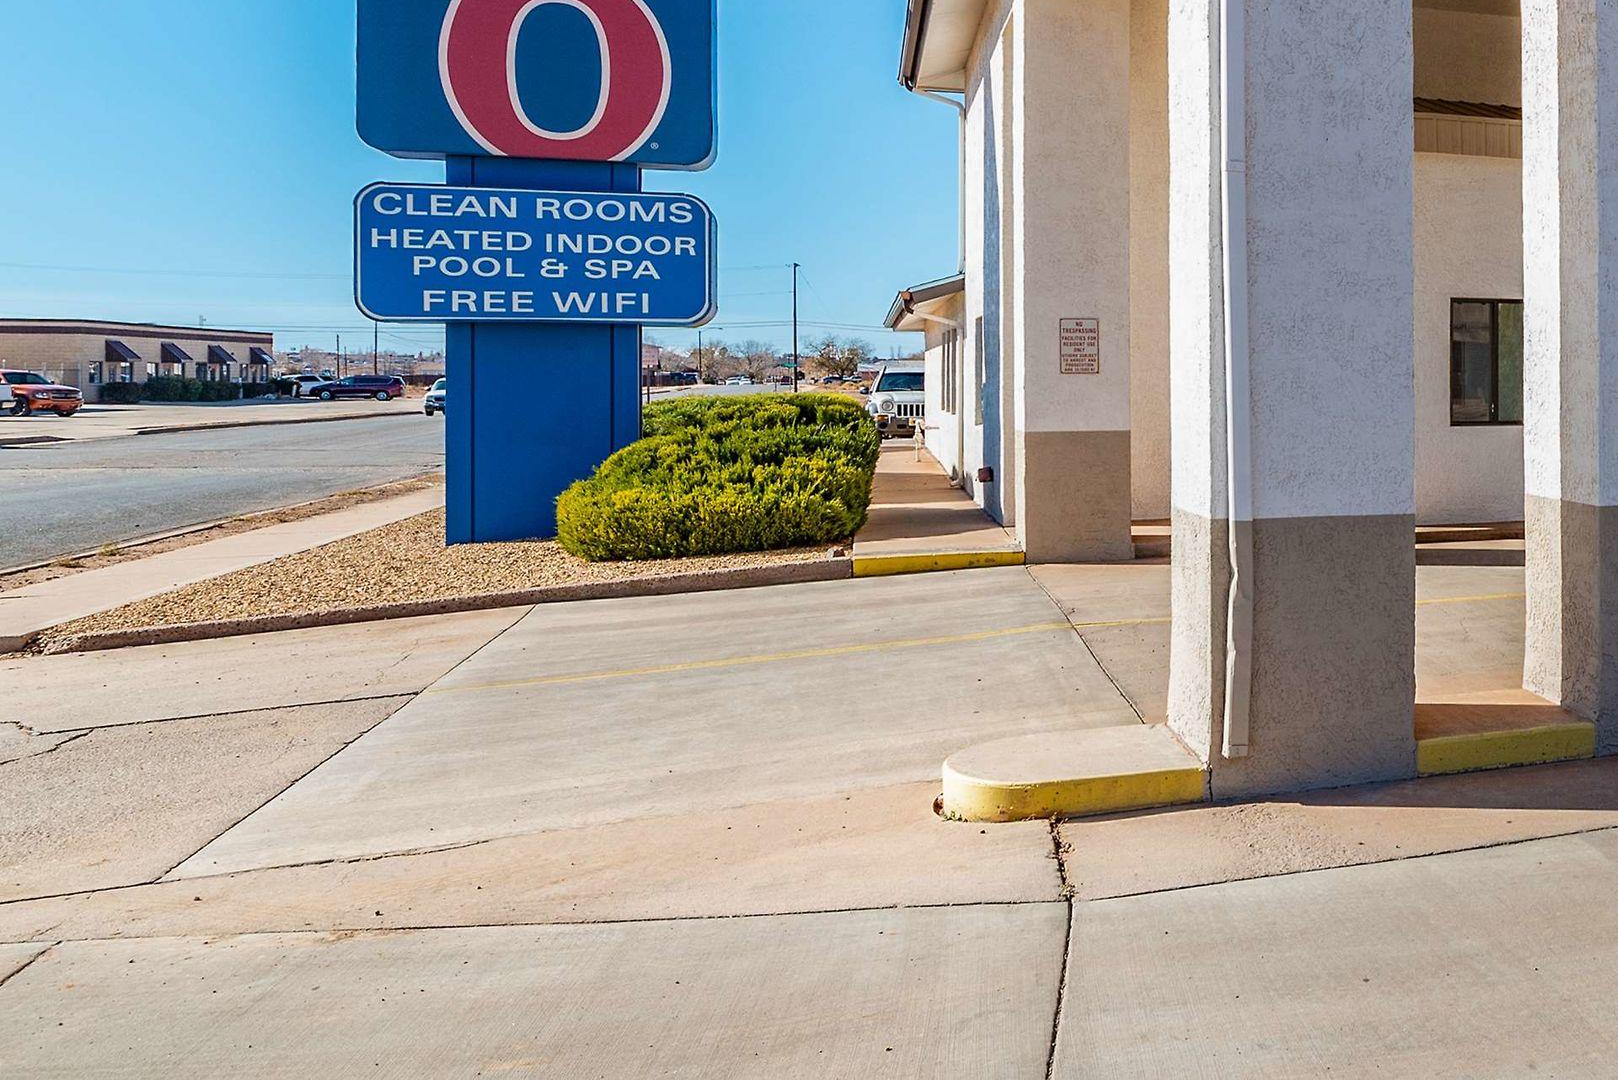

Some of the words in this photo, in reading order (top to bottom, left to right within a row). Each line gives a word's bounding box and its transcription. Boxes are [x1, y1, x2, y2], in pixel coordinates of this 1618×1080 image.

[373, 192, 517, 219] CLEAN
[535, 197, 694, 224] ROOMS
[370, 228, 533, 252] HEATED
[545, 233, 696, 256] INDOOR
[412, 255, 525, 278] POOL
[540, 258, 568, 279] &
[584, 259, 661, 280] SPA
[422, 290, 535, 313] FREE
[552, 291, 650, 314] WIFI
